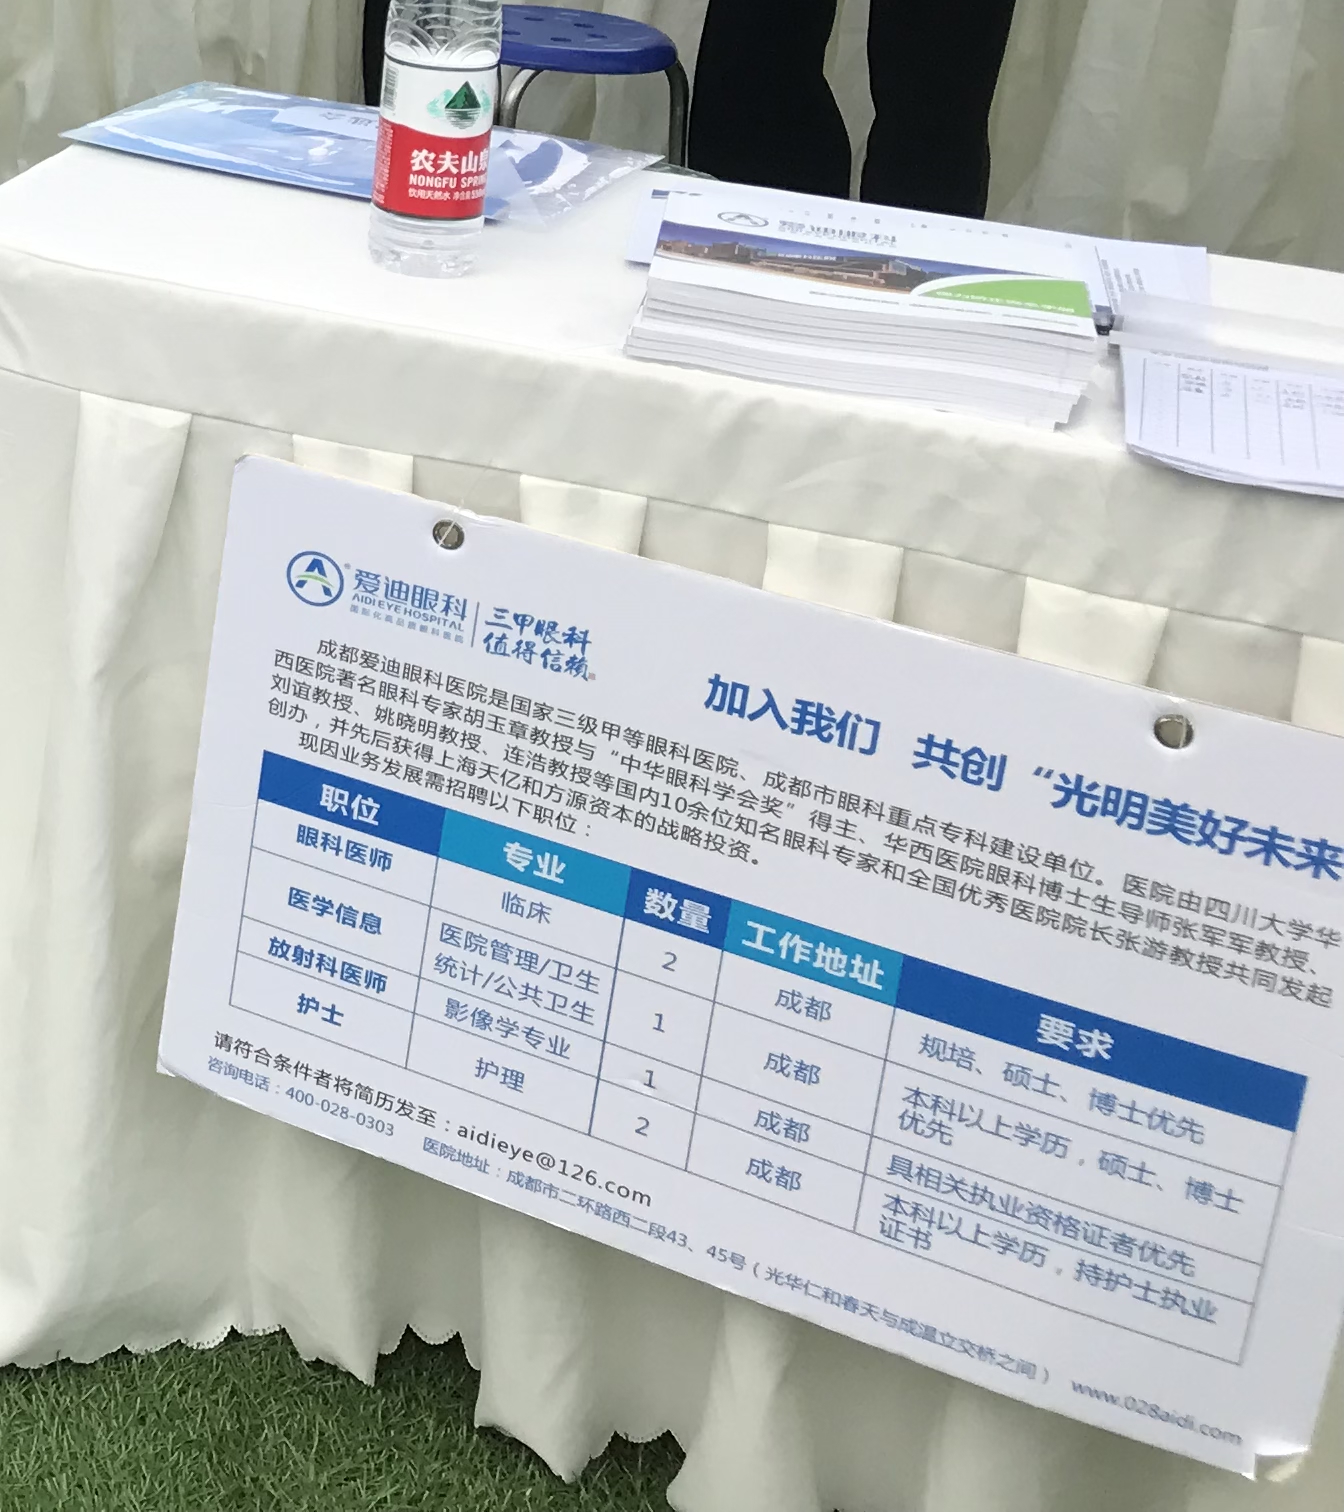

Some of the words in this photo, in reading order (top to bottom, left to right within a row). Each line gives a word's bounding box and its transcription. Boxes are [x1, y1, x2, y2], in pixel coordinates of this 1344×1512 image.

[408, 173, 458, 189] NONGFU
[410, 148, 489, 175] 农夫山泉
[351, 592, 376, 607] AIDI
[377, 599, 402, 614] EYE
[403, 607, 465, 633] HOSPITAL
[353, 568, 468, 622] 爱迪眼科
[484, 607, 592, 656] 三甲眼科
[703, 673, 882, 756] 加入我们
[911, 733, 1008, 792] 共创
[1033, 766, 1344, 882] “光明美好未来
[319, 783, 381, 826] 职位
[295, 823, 394, 873] 眼科医师
[502, 842, 566, 884] 专业
[287, 886, 382, 936] 医学信息
[501, 891, 552, 925] 临床
[643, 887, 712, 934] 数量
[267, 935, 388, 995] 放射科医师
[439, 922, 600, 995] 医院管理/卫生
[661, 951, 678, 973] 2
[741, 920, 885, 991] 工作地址
[296, 992, 344, 1027] 护士
[433, 952, 595, 1026] 统计/公共卫生
[774, 988, 833, 1023] 成都
[444, 997, 571, 1061] 影像学专业
[652, 1013, 666, 1034] 1
[1036, 1013, 1115, 1060] 要求
[474, 1056, 525, 1094] 护理
[642, 1069, 657, 1090] 1
[763, 1052, 822, 1086] 成都
[917, 1033, 1205, 1146] 规培、硕士、博士优先
[634, 1116, 650, 1138] 2
[753, 1109, 811, 1144] 成都
[897, 1108, 954, 1147] 优先
[745, 1157, 803, 1192] 成都
[879, 1214, 933, 1252] 证书
[885, 1154, 1196, 1278] 具相关执业资格证者优先
[1071, 1380, 1244, 1446] www.028aidi.com
